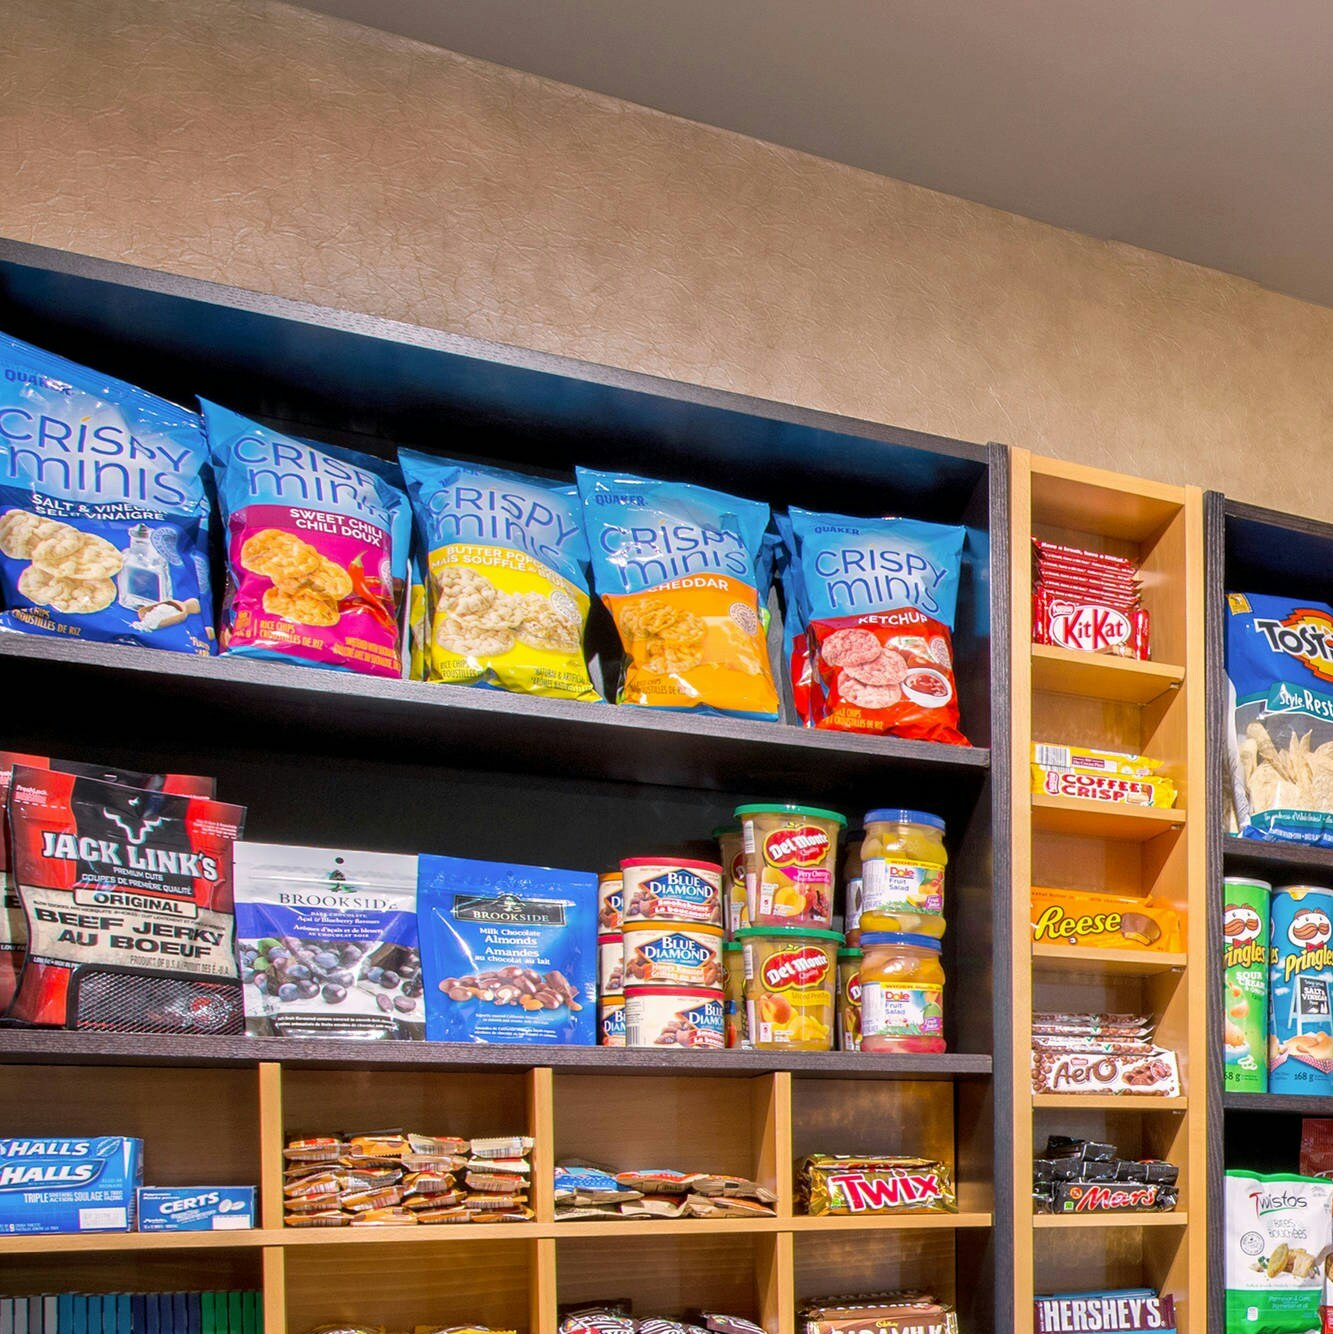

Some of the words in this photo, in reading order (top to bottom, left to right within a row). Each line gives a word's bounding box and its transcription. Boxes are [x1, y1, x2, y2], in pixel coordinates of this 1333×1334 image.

[0, 408, 192, 473] CRISPY
[289, 509, 344, 528] SWEET
[348, 522, 383, 539] CHILI
[814, 525, 860, 536] QUAKER
[814, 548, 947, 589] CRISPY
[858, 614, 928, 626] KETCHUP
[1062, 609, 1124, 648] KitKat
[1061, 773, 1140, 793] COFFEE
[1061, 786, 1125, 801] CRISP
[41, 830, 120, 864] JACK
[128, 844, 219, 882] LINK'S
[768, 842, 793, 859] Del
[792, 829, 829, 850] Monte
[113, 865, 143, 879] PREMIUM
[666, 872, 701, 887] BLUE
[889, 866, 915, 878] Dole
[650, 882, 714, 898] DIAMOND
[94, 891, 183, 915] ORIGINAL
[34, 907, 124, 931] BEEF
[132, 920, 225, 946] JERKY
[472, 909, 550, 923] BROOKSIDE
[1034, 905, 1121, 940] Reese
[57, 928, 97, 947] AU
[110, 935, 212, 960] BOEUF
[484, 935, 537, 947] Almonds
[6, 1140, 90, 1157] HALLS
[159, 1191, 220, 1215] CERTS
[1043, 1298, 1162, 1333] HERSHEY'S
